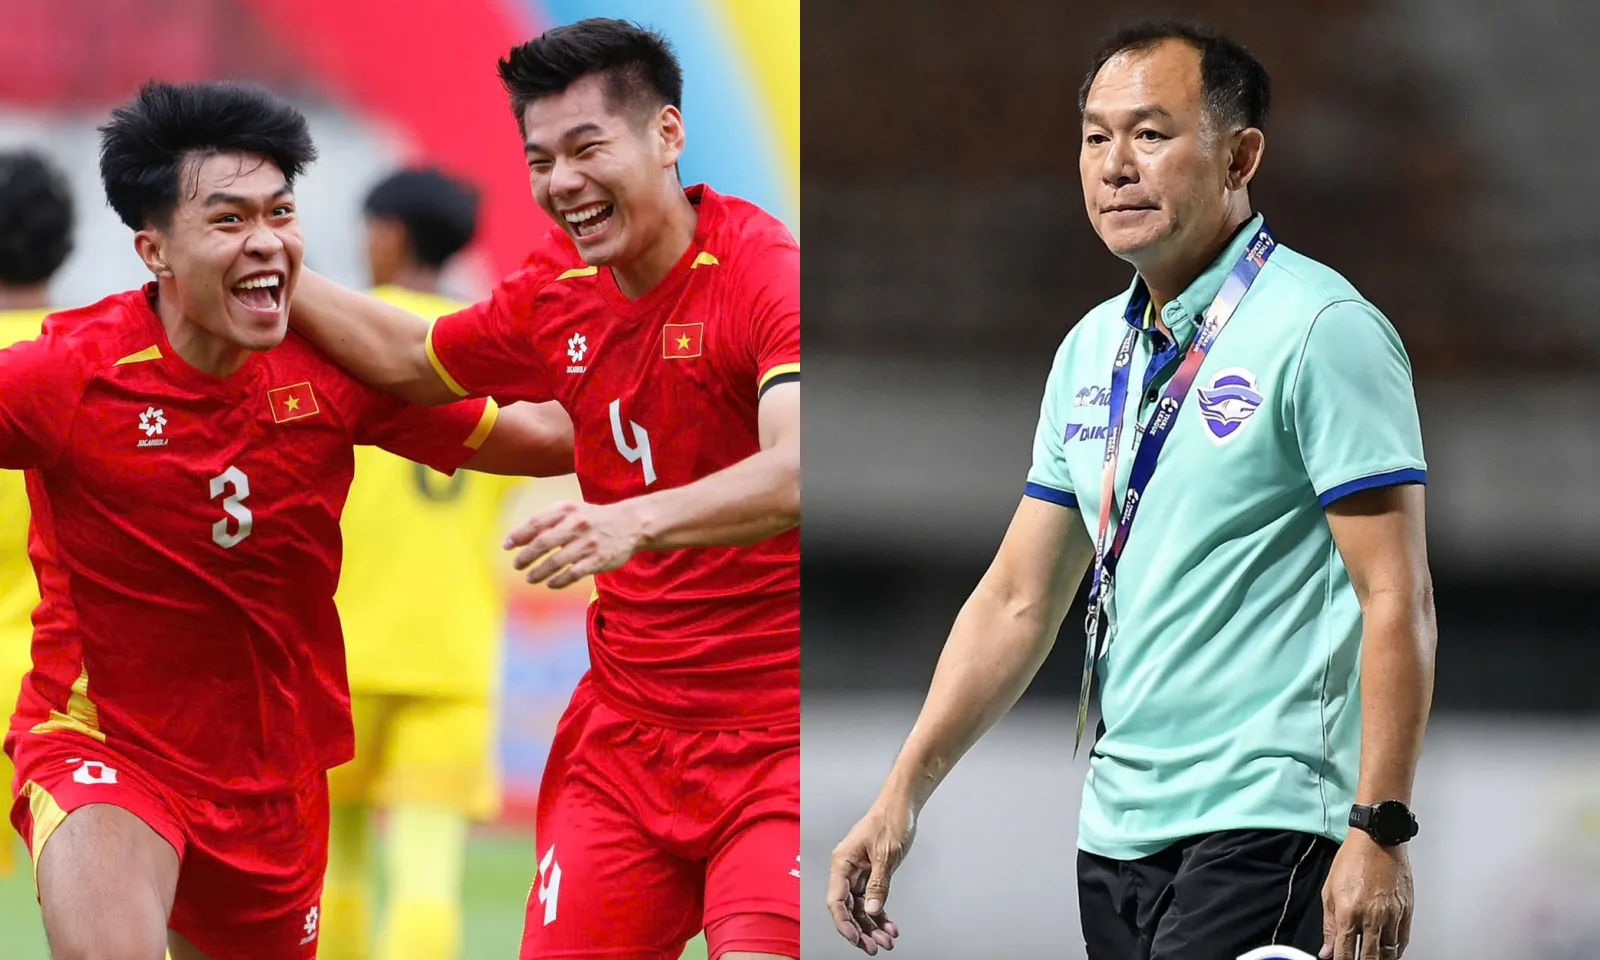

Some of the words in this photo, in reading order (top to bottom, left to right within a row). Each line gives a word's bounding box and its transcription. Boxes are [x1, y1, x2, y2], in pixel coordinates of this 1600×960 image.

[609, 398, 658, 486] 4
[1149, 410, 1166, 437] LEAGUE
[1160, 412, 1172, 431] THAI
[209, 465, 253, 549] 3
[539, 843, 562, 927] 4
